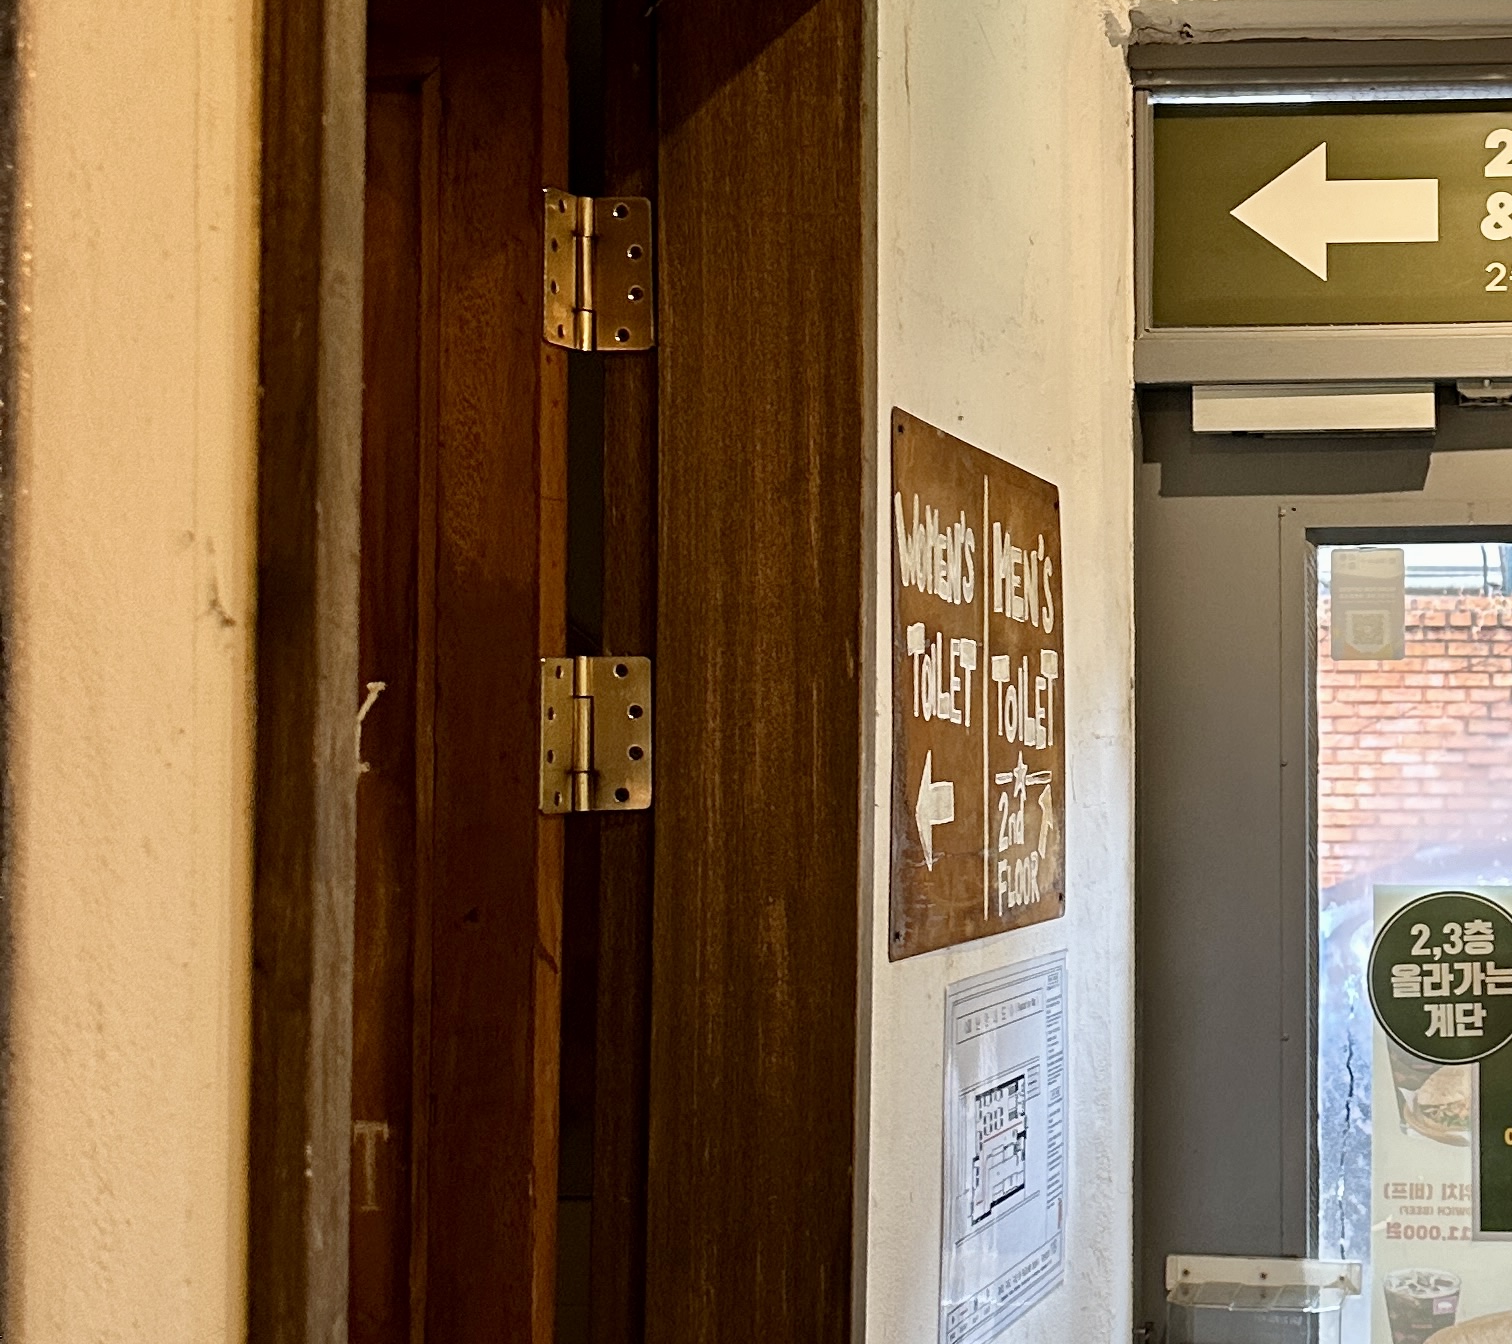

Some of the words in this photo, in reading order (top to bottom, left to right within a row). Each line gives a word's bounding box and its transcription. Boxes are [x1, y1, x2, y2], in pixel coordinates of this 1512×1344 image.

[993, 521, 1054, 634] MEN'S
[998, 791, 1025, 852] 2nd
[997, 851, 1041, 917] FLOOR
[1410, 919, 1495, 960] 2,3층
[1424, 1003, 1487, 1037] 계단
